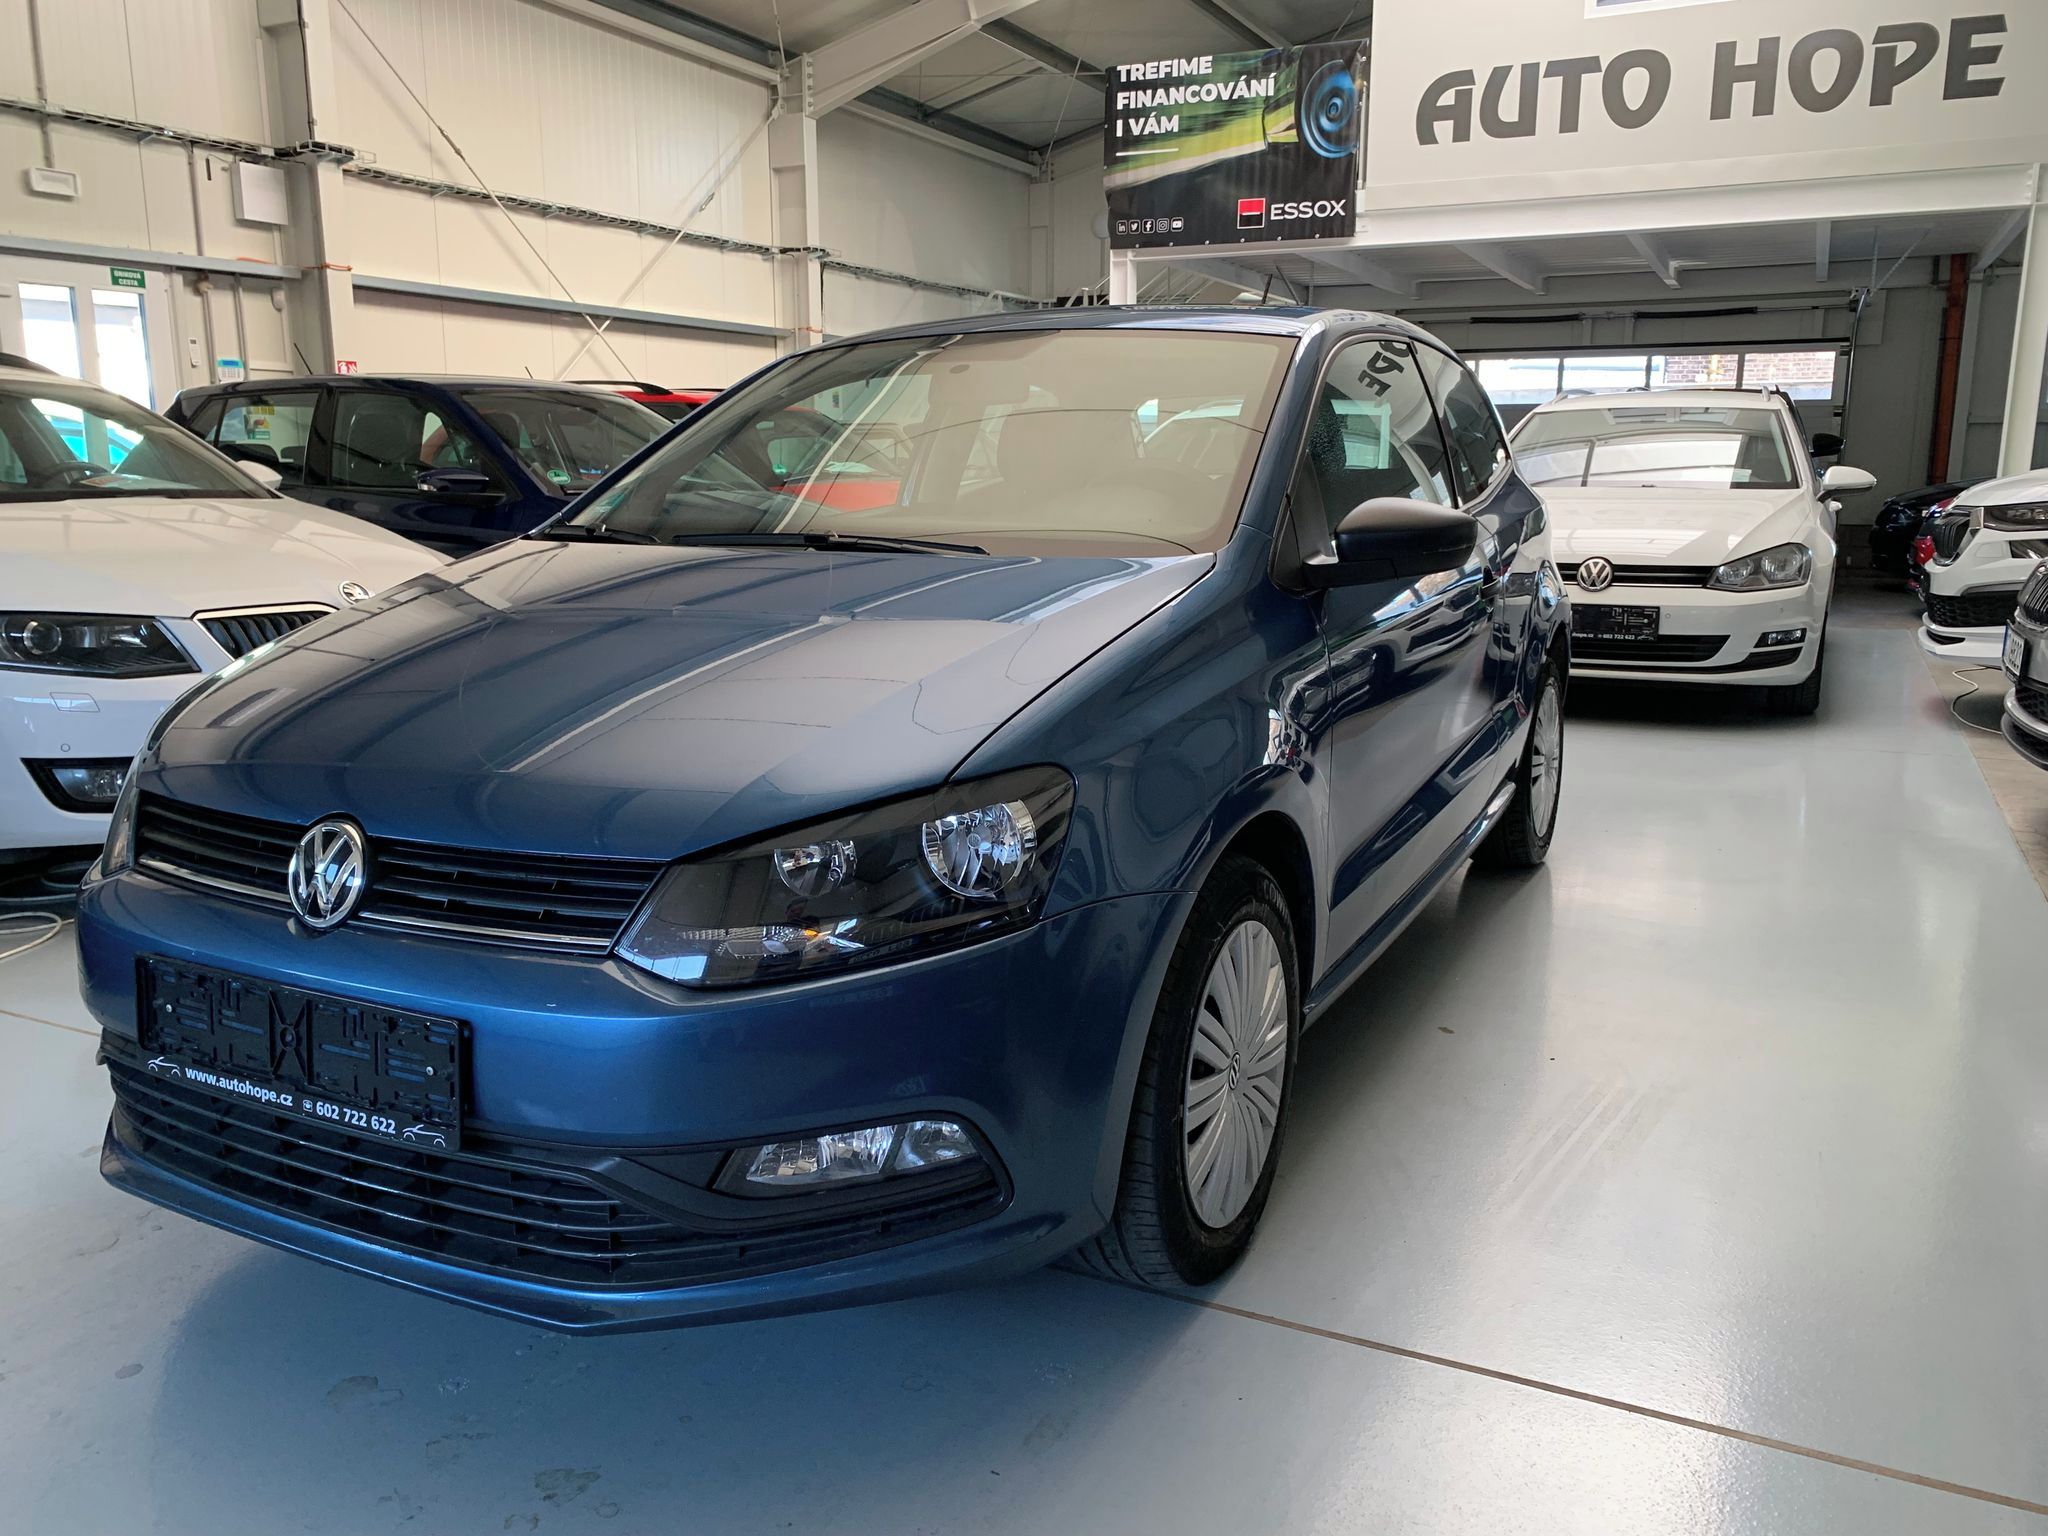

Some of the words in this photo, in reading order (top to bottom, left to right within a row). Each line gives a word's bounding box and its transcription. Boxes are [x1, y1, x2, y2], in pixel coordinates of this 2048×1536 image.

[1116, 55, 1213, 82] TREFIME
[1416, 48, 1671, 146] AUTO
[1709, 14, 2008, 121] HOPE
[1116, 73, 1277, 110] FINANCOVÁNÍ
[1116, 119, 1123, 137] I
[1128, 112, 1179, 136] VÁM
[1270, 199, 1346, 220] ESSOX
[118, 278, 139, 286] CESTA
[289, 820, 365, 929] VW
[185, 1067, 293, 1107] www.autohope.cz
[316, 1101, 340, 1120] 602
[343, 1108, 367, 1127] 722
[371, 1115, 396, 1134] 622
